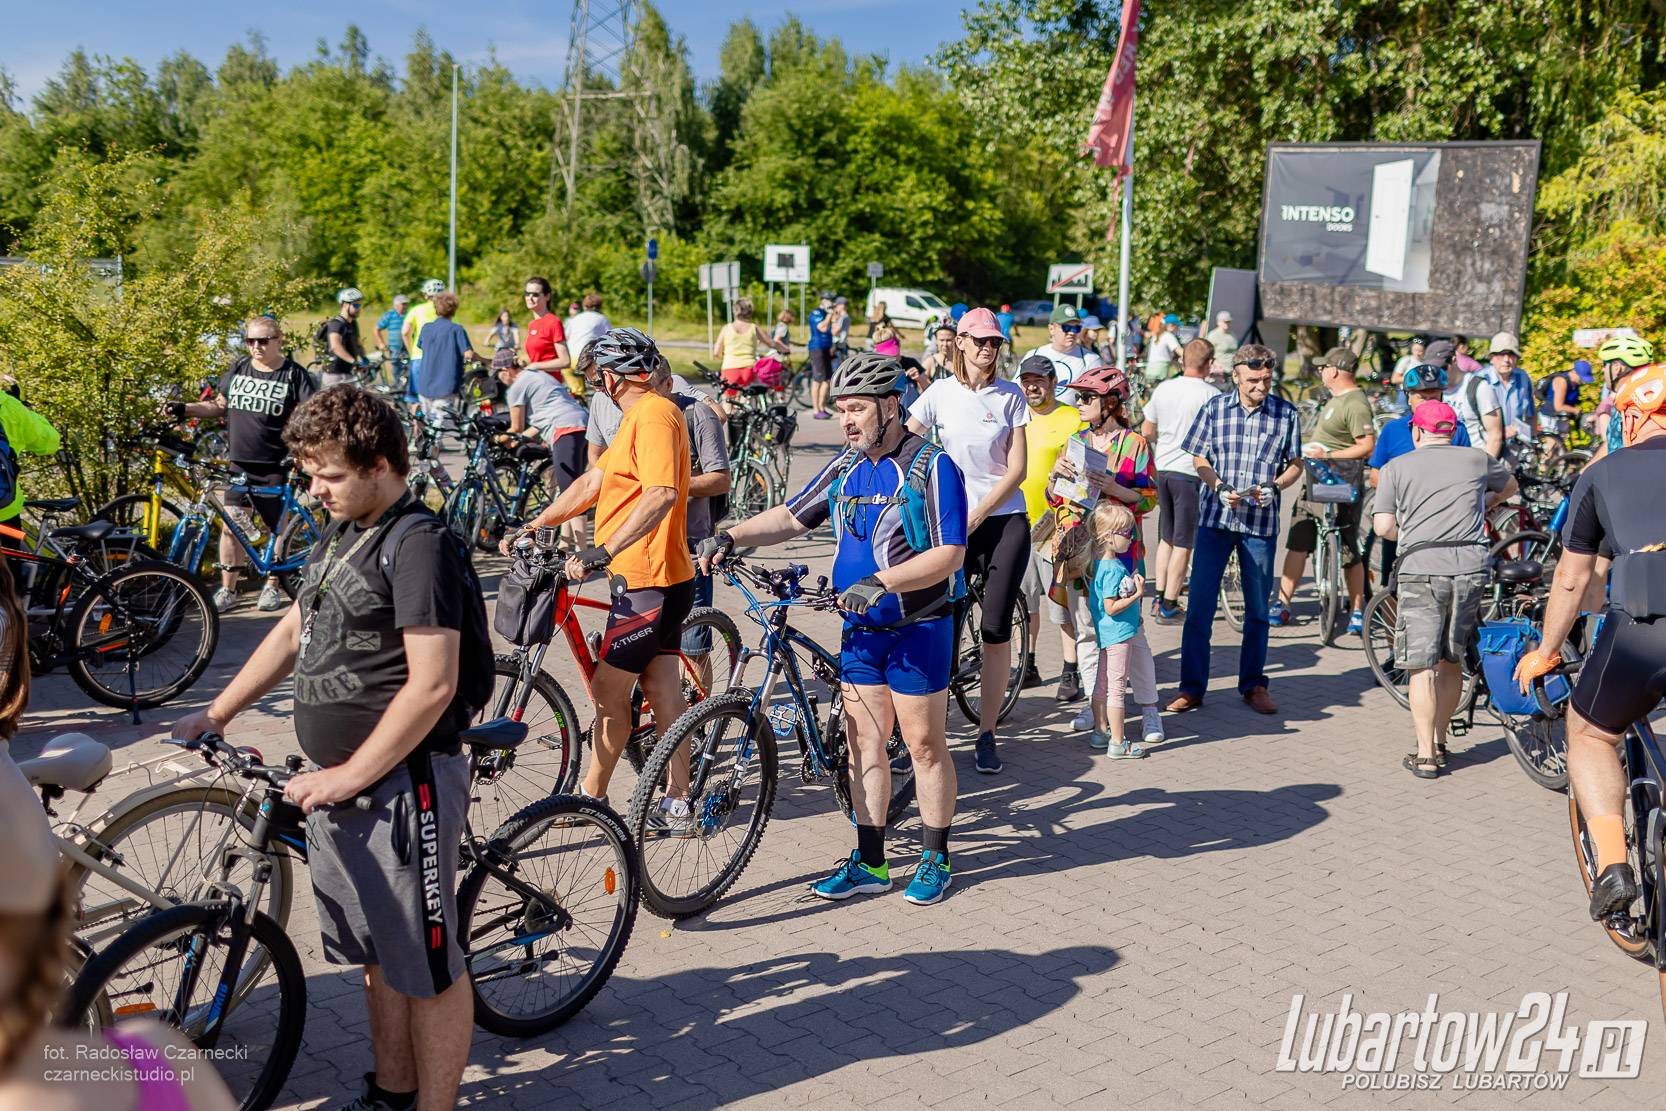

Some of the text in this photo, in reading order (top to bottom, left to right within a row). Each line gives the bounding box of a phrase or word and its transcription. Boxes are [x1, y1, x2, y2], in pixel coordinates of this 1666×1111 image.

[1281, 205, 1355, 223] INTENSO
[229, 376, 287, 402] MORE
[578, 807, 628, 842] CST HEATHEN
[420, 810, 444, 924] SUPERKEY
